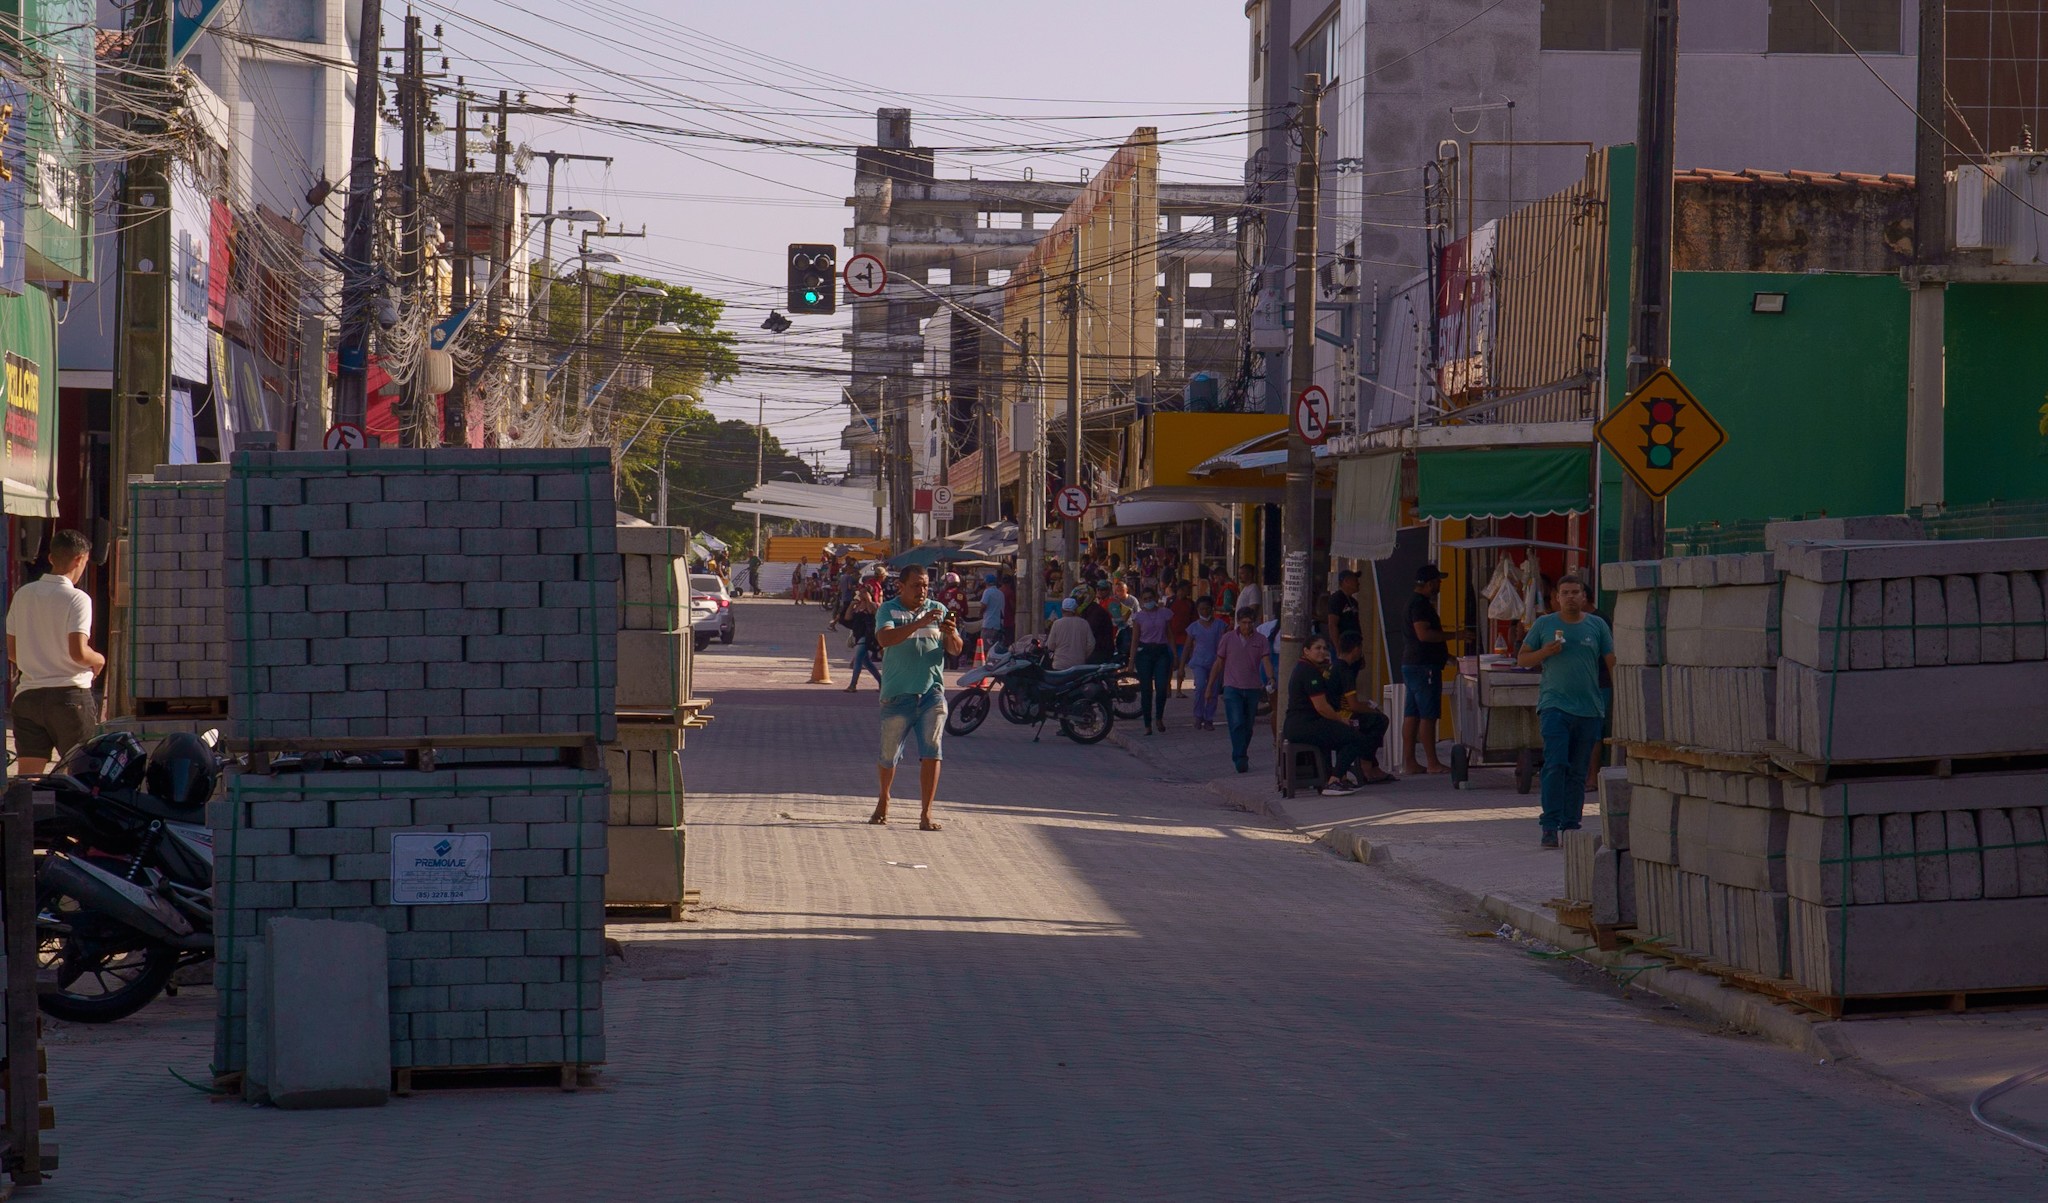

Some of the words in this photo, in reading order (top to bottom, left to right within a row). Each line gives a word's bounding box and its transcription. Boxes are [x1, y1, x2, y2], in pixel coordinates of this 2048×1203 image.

[1307, 398, 1320, 431] E
[939, 490, 946, 501] E
[1066, 493, 1080, 511] E
[416, 891, 430, 900] (85)
